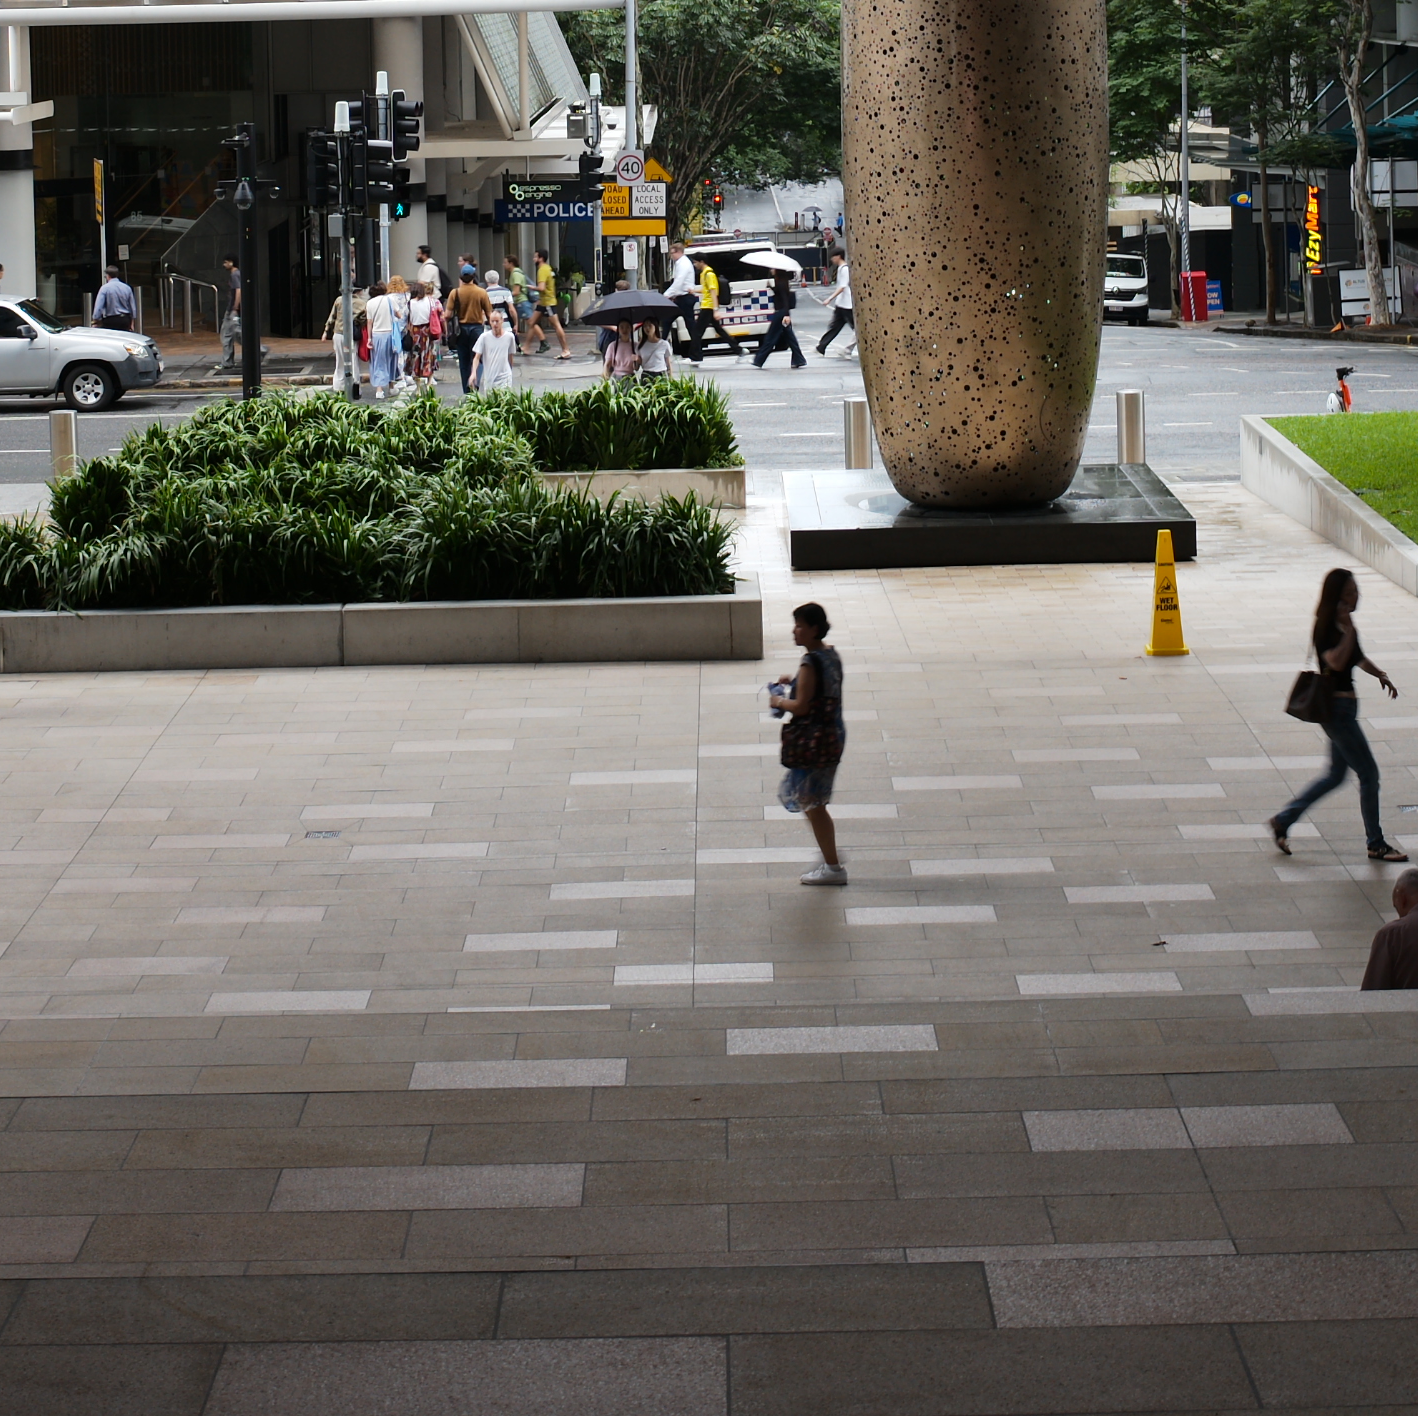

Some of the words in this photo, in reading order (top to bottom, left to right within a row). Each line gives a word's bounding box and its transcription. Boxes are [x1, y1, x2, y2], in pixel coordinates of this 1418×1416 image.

[621, 161, 640, 174] 40
[637, 185, 661, 193] LOCAL
[525, 191, 553, 200] engine
[603, 196, 627, 204] LOSED
[635, 196, 664, 204] ACCESS
[534, 203, 593, 218] POLICE
[639, 206, 659, 215] ONLY
